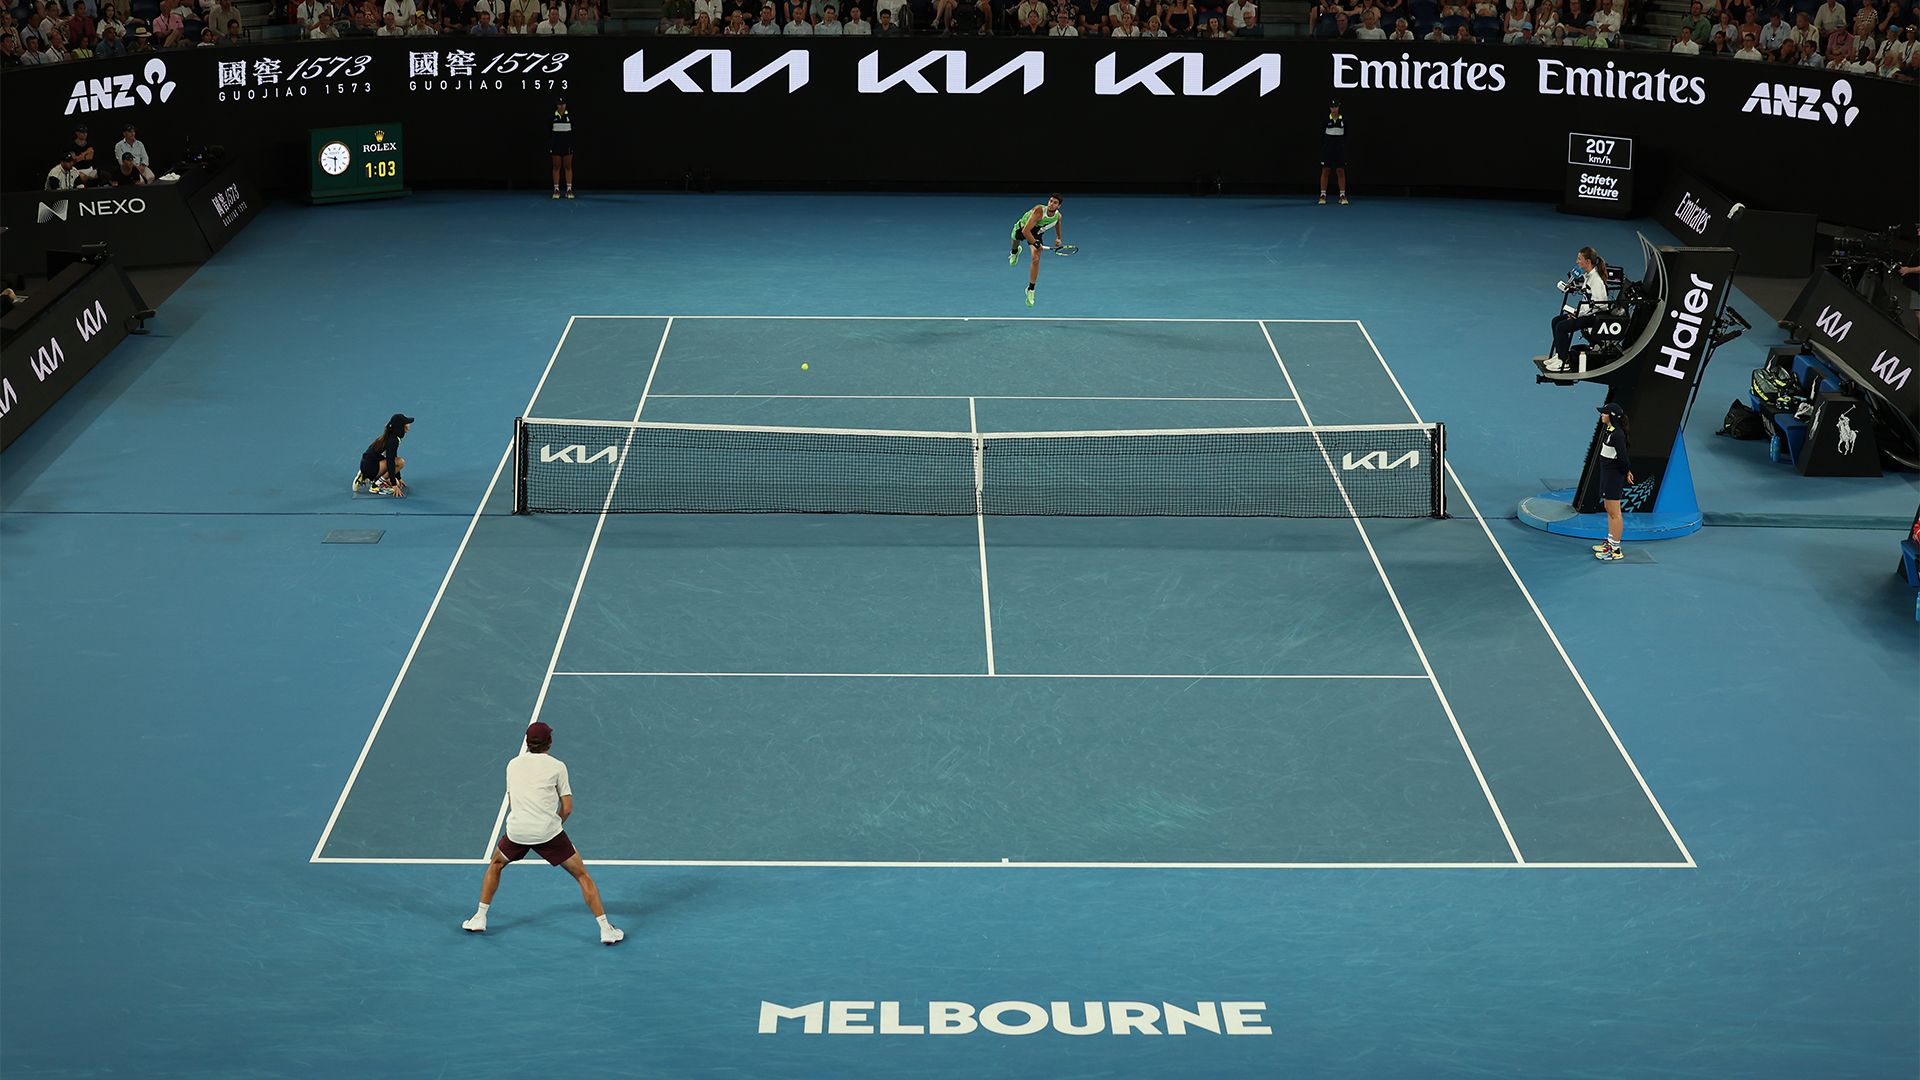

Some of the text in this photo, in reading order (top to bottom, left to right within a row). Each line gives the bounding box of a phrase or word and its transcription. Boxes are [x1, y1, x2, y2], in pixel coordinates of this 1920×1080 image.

[409, 79, 568, 91] GUOJIAO 1573
[623, 49, 810, 94] KIA
[857, 50, 1045, 95] KIA
[1094, 52, 1282, 97] KIA
[1332, 52, 1506, 92] Emirates
[1538, 58, 1706, 104] Emirates
[64, 77, 136, 116] ANZ
[218, 82, 371, 101] GUOJIAO 1573
[1742, 83, 1821, 121] ANZ
[363, 142, 397, 153] ROLEX
[1586, 138, 1616, 155] 207
[1588, 154, 1612, 165] km/h
[365, 161, 396, 178] 1:03
[1580, 173, 1618, 189] Safety
[79, 198, 146, 217] NEXO
[1578, 184, 1619, 198] Culture
[1674, 191, 1712, 235] Emirates
[75, 300, 108, 342] KIA
[1654, 273, 1714, 380] Haier
[1815, 304, 1853, 343] KIA
[30, 337, 65, 382] KIA
[1870, 349, 1912, 391] KIA
[540, 444, 618, 465] KIA
[1342, 450, 1420, 470] KIA
[758, 1000, 1273, 1036] MELBOURNE
